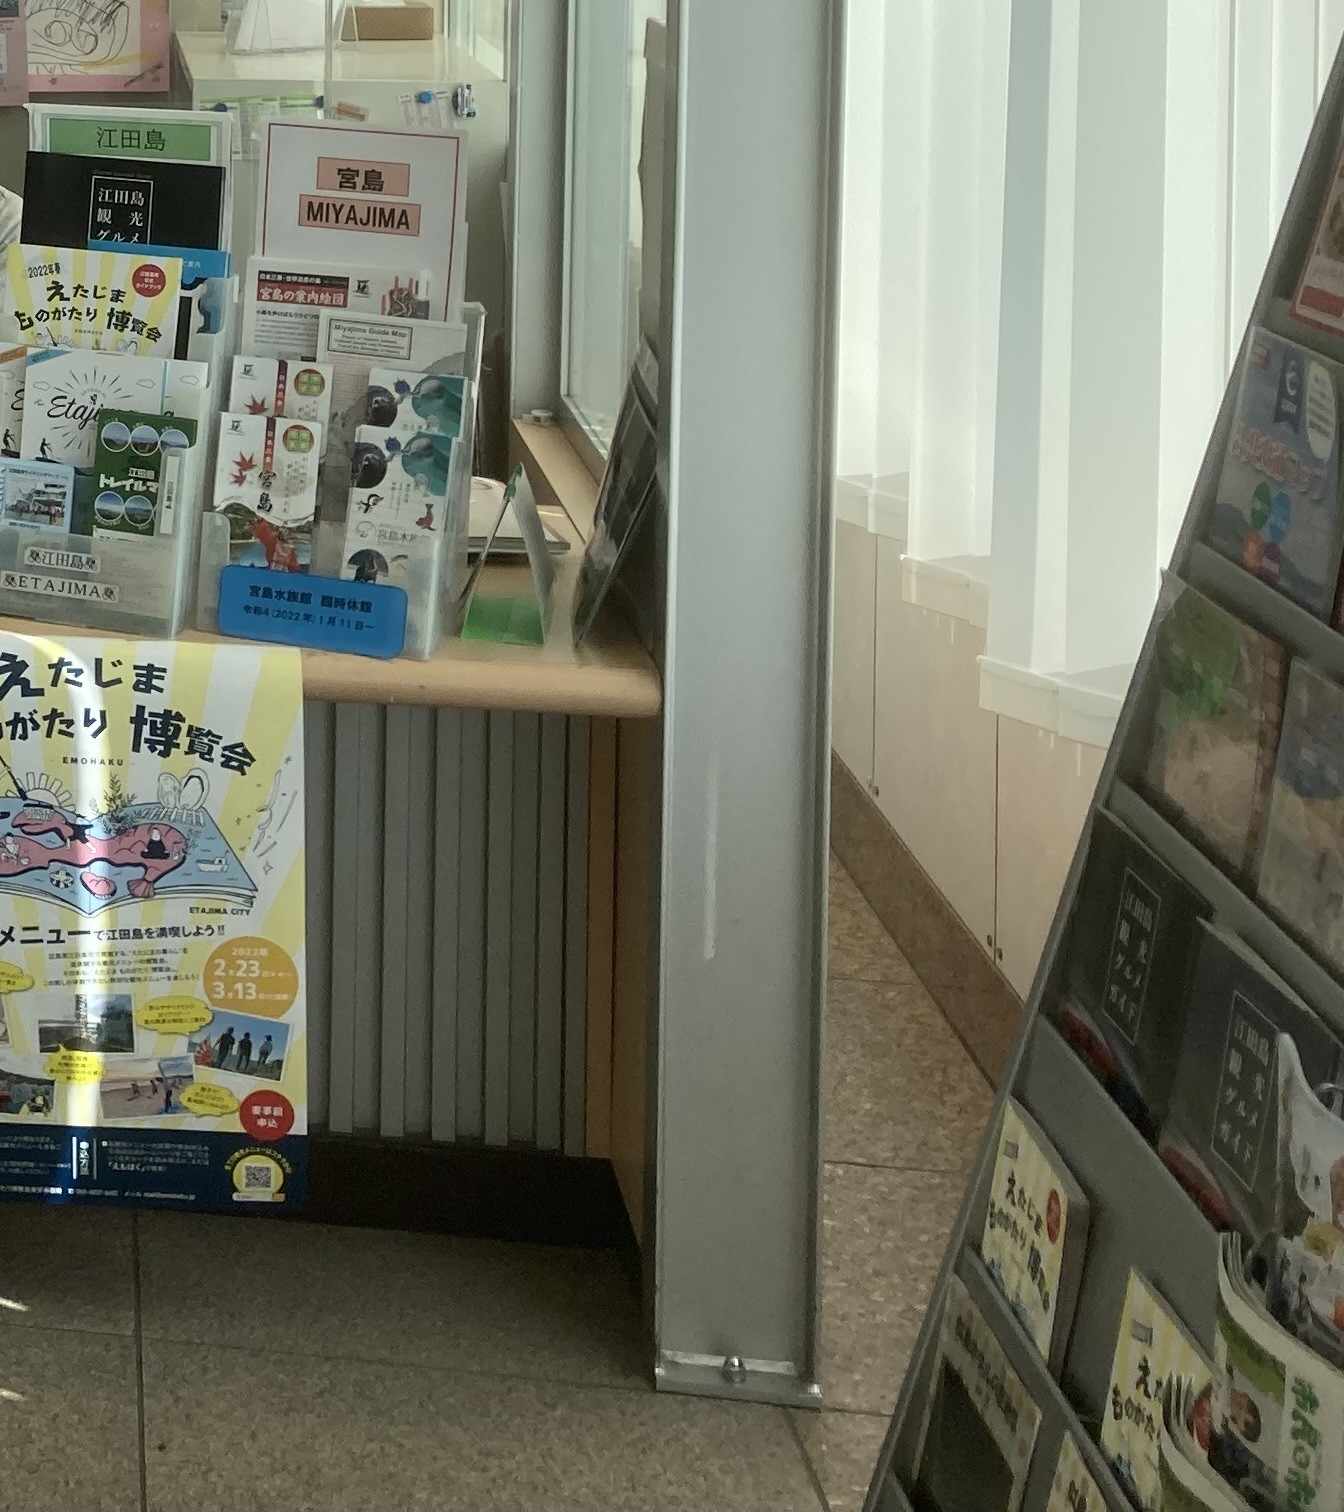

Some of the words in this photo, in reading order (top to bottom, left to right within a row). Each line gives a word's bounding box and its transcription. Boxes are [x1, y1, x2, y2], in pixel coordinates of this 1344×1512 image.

[96, 126, 167, 152] 江田島
[336, 166, 385, 192] 宮島
[98, 187, 145, 207] 江田島
[96, 207, 144, 227] 観光
[306, 200, 411, 231] MIYAJIMA
[46, 280, 127, 303] えたじま
[14, 306, 98, 331] ものがたり
[106, 307, 162, 343] 博覧会
[18, 575, 102, 598] ETAJIMA
[129, 704, 257, 776] 博覧会
[62, 756, 125, 767] EMOHAKU
